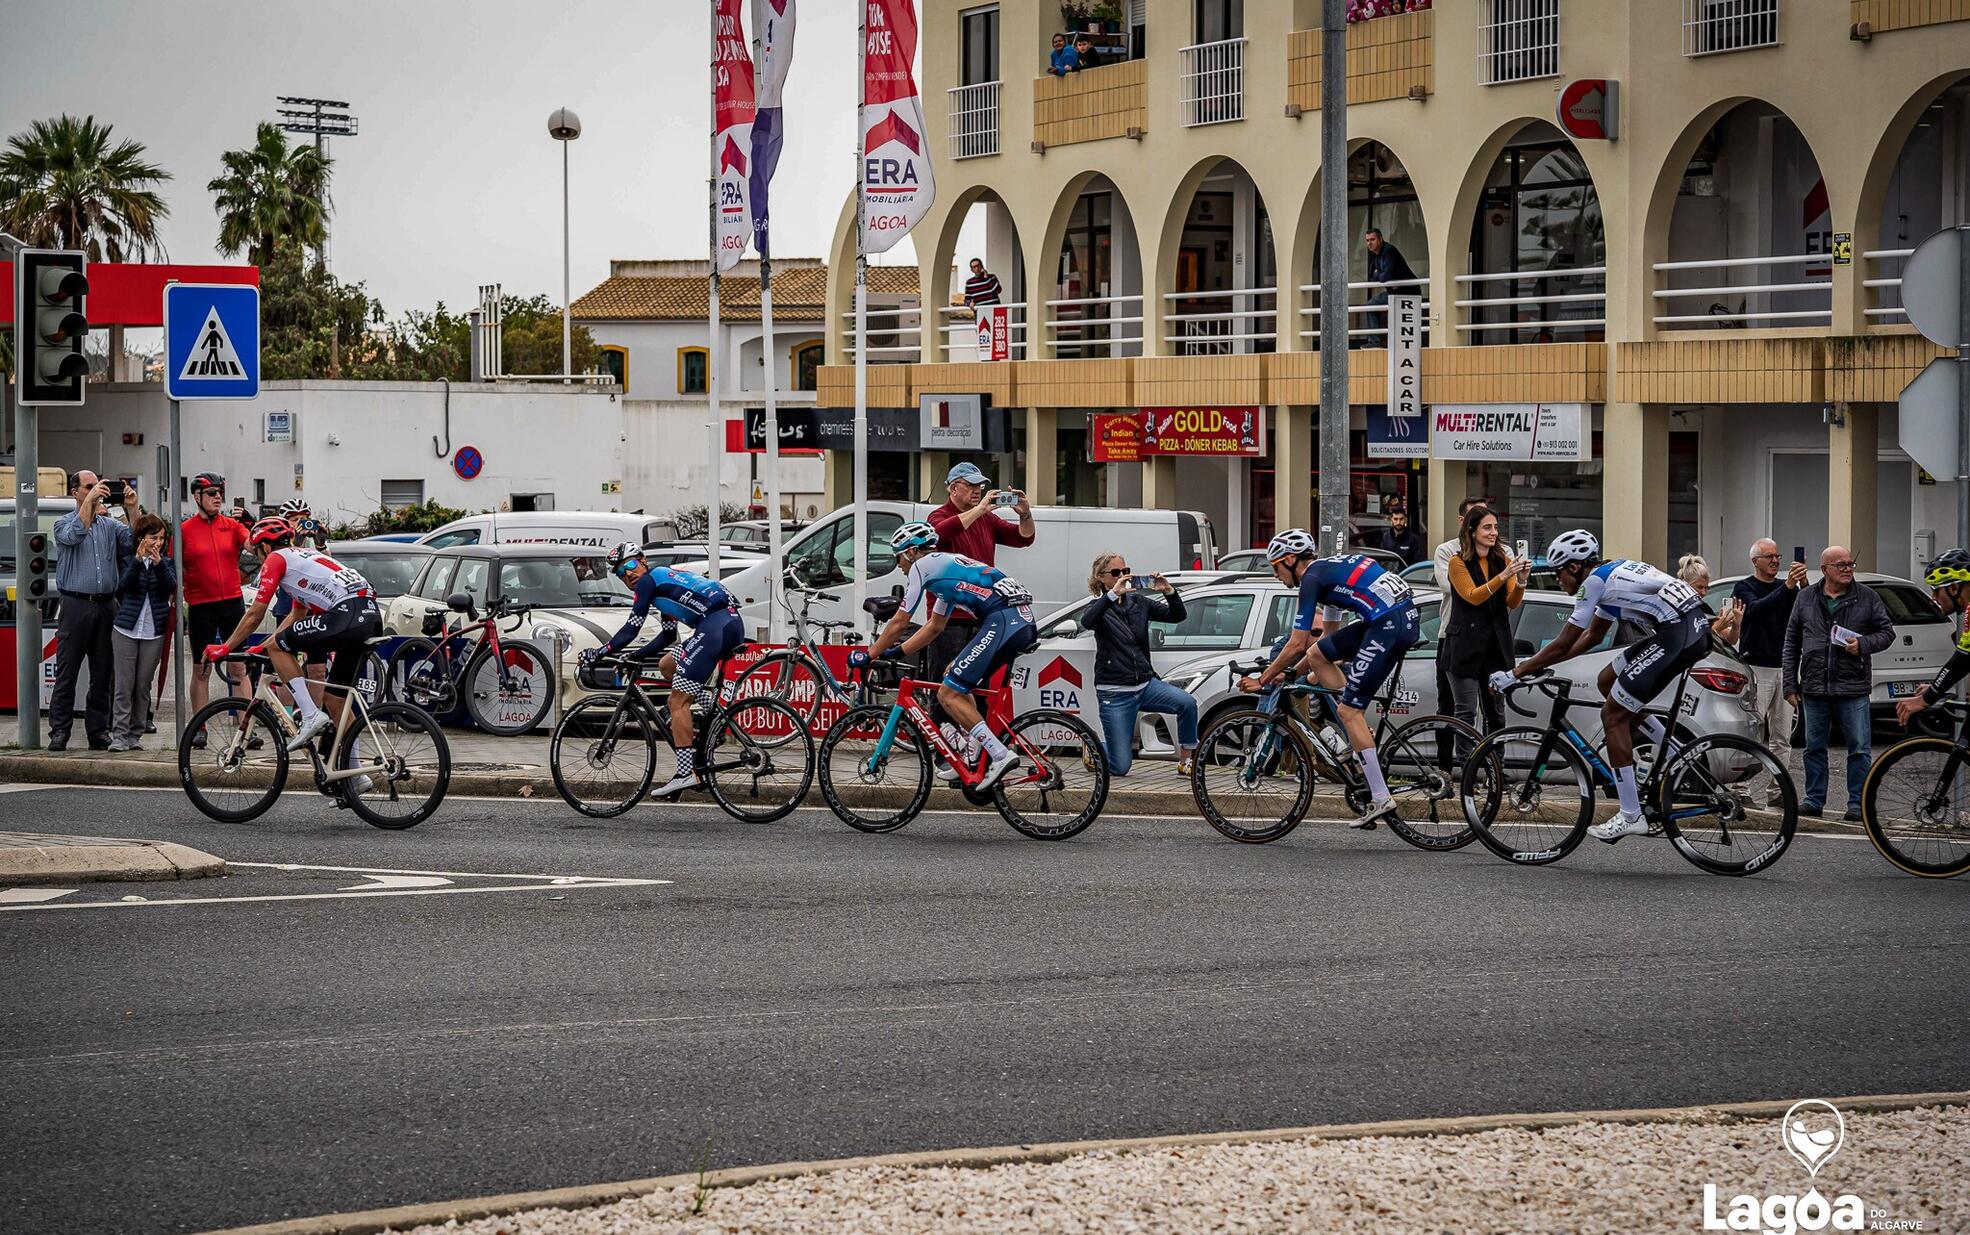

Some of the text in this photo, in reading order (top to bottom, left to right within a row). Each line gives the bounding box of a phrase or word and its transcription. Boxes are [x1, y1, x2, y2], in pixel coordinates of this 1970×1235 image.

[866, 158, 918, 184] ERA
[1400, 300, 1414, 349] RENT
[1400, 376, 1414, 411] CAR
[1174, 411, 1222, 432] GOLD
[1222, 416, 1237, 434] Food
[1436, 413, 1531, 432] MULTIRENTAL
[1160, 439, 1180, 450] PIZZA
[1212, 439, 1238, 451] KEBAB
[1454, 440, 1512, 451] Car Hire Solutions
[959, 630, 997, 669] Credibom
[1350, 639, 1386, 684] Kelly
[1627, 648, 1665, 681] rolear
[360, 678, 376, 691] 185
[1013, 666, 1025, 686] 194
[1041, 690, 1080, 708] ERA
[1399, 691, 1418, 702] 214
[500, 712, 532, 722] LAGOA
[757, 707, 783, 729] BUY
[1041, 730, 1081, 741] LAGOA
[1513, 849, 1561, 861] FFWD
[1745, 834, 1785, 871] FFWD
